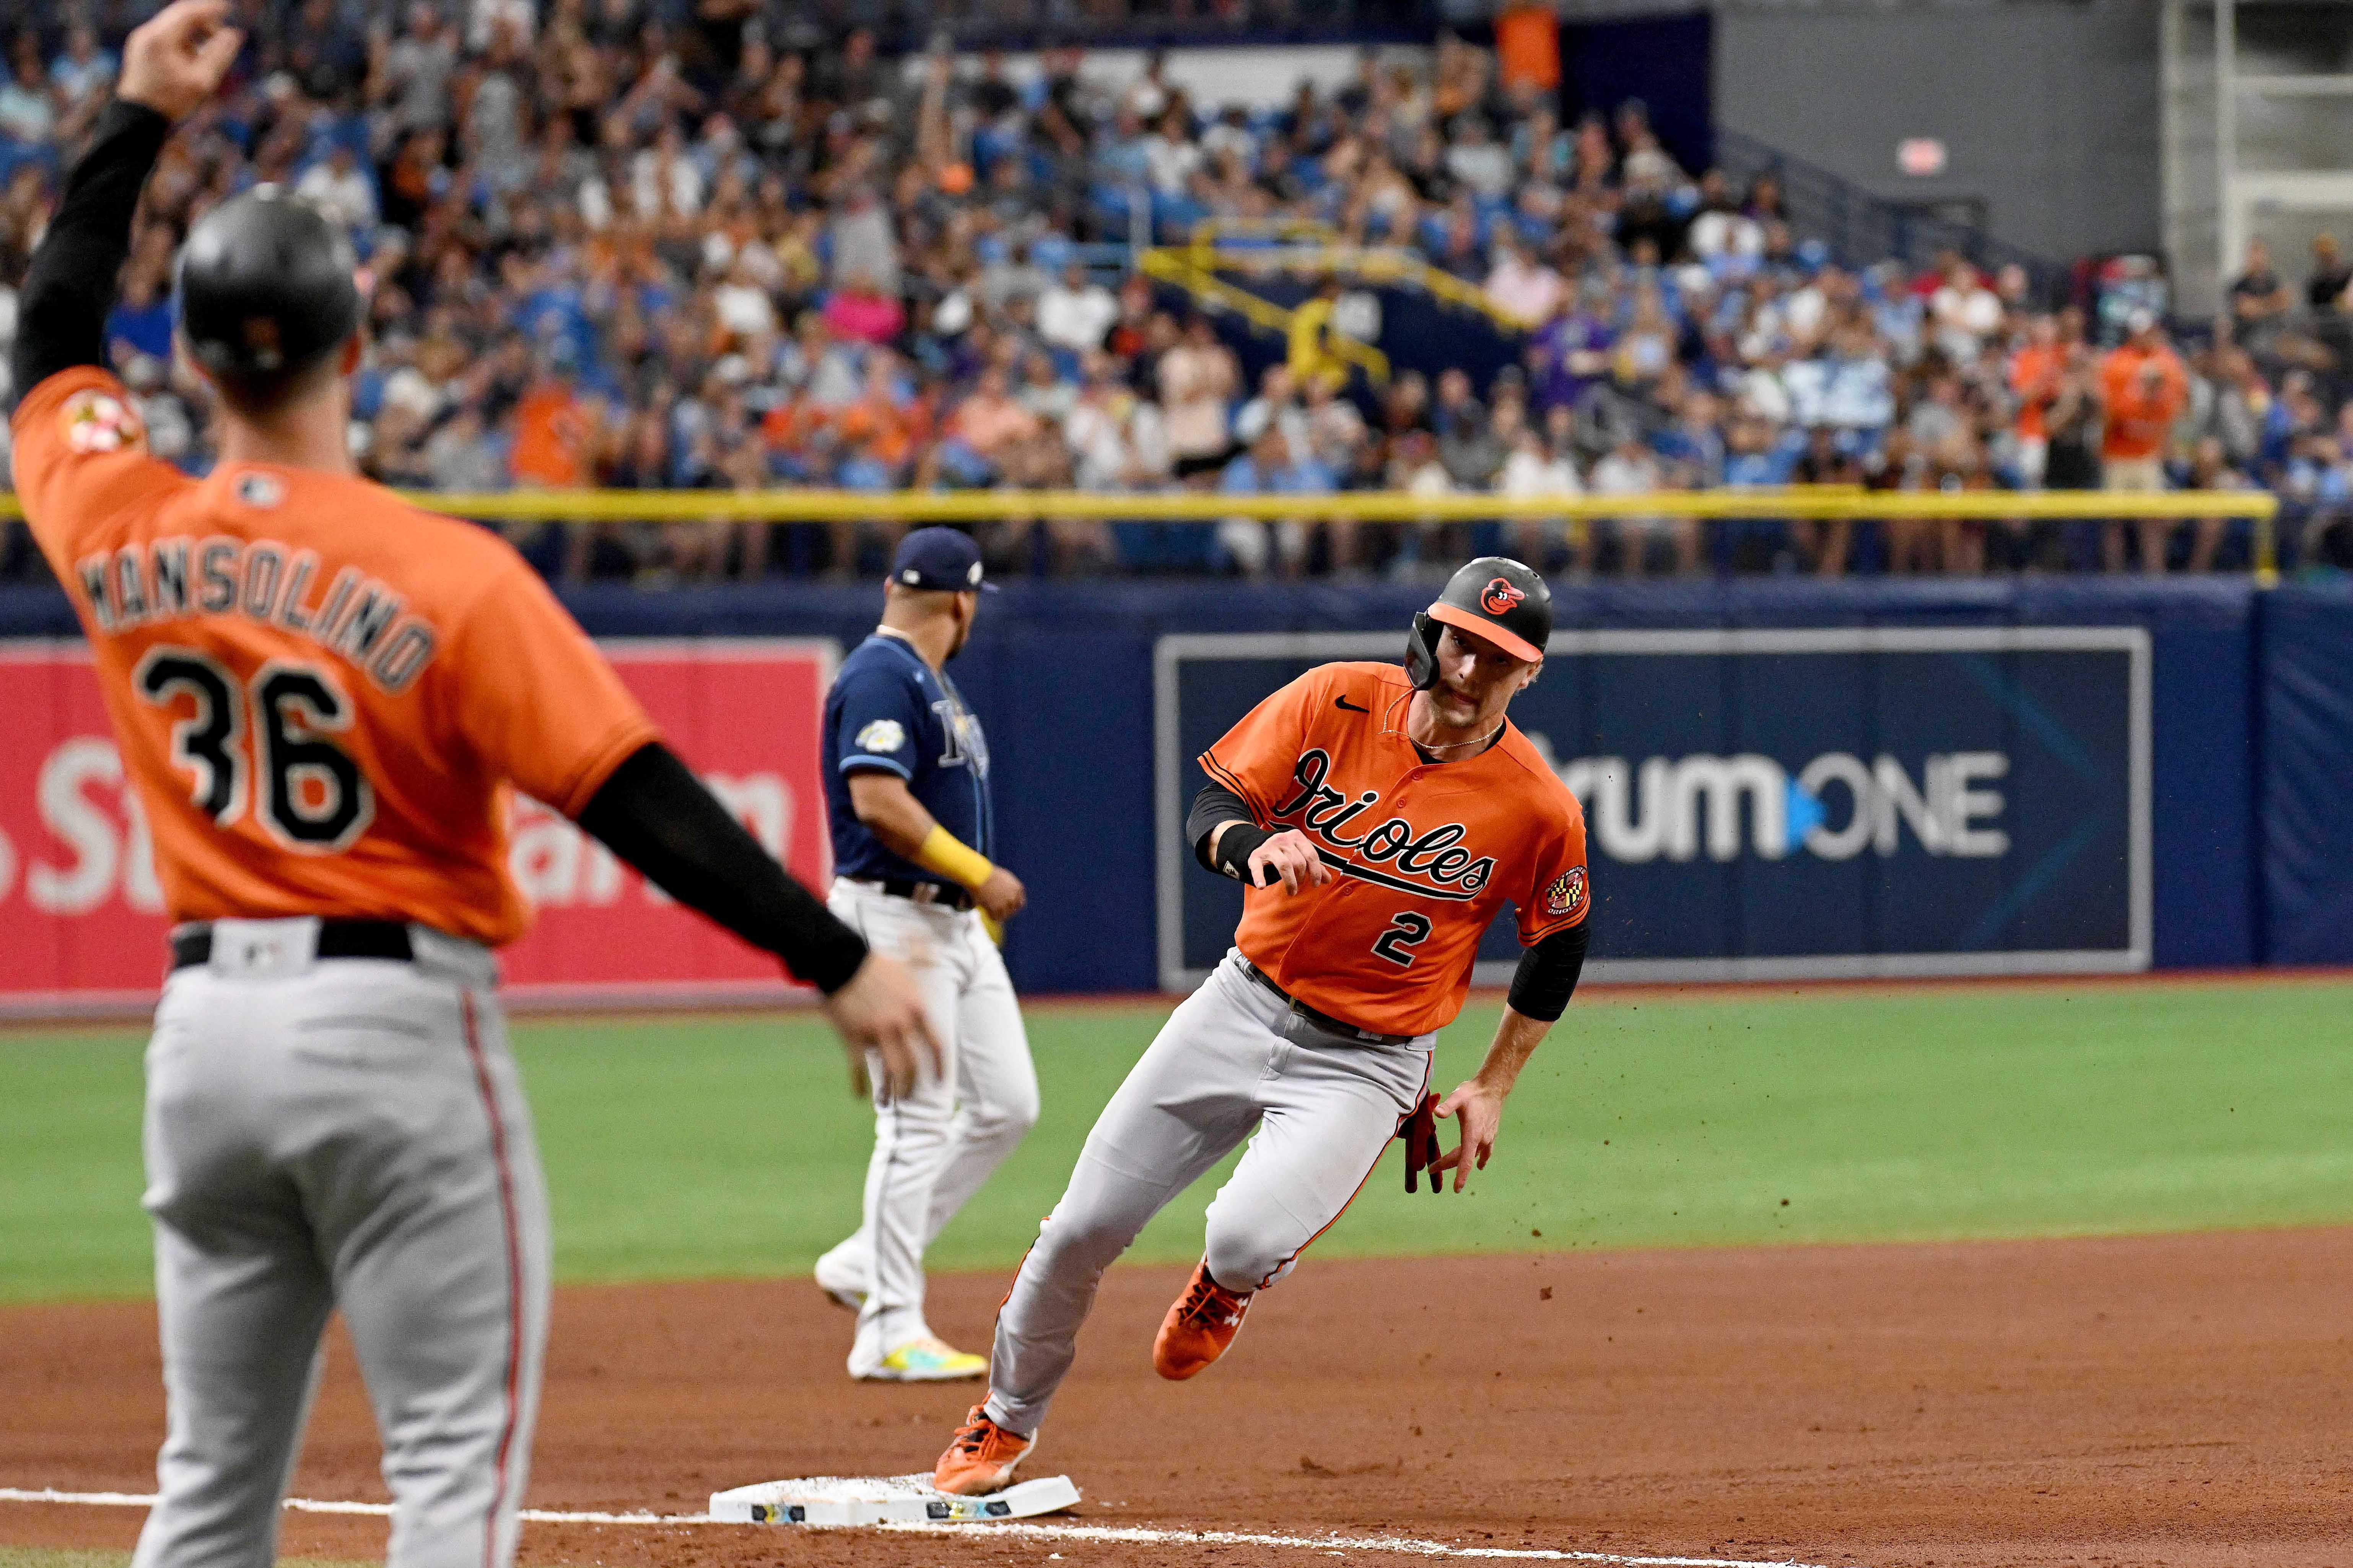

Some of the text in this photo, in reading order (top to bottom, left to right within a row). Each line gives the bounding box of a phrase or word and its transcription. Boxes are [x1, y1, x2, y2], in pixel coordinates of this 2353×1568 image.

[76, 533, 441, 697] MANSOLINO
[132, 644, 376, 857] 36
[1272, 748, 1498, 895] Orioles
[1370, 911, 1434, 968] 2
[1548, 895, 1583, 915] ORIOLES
